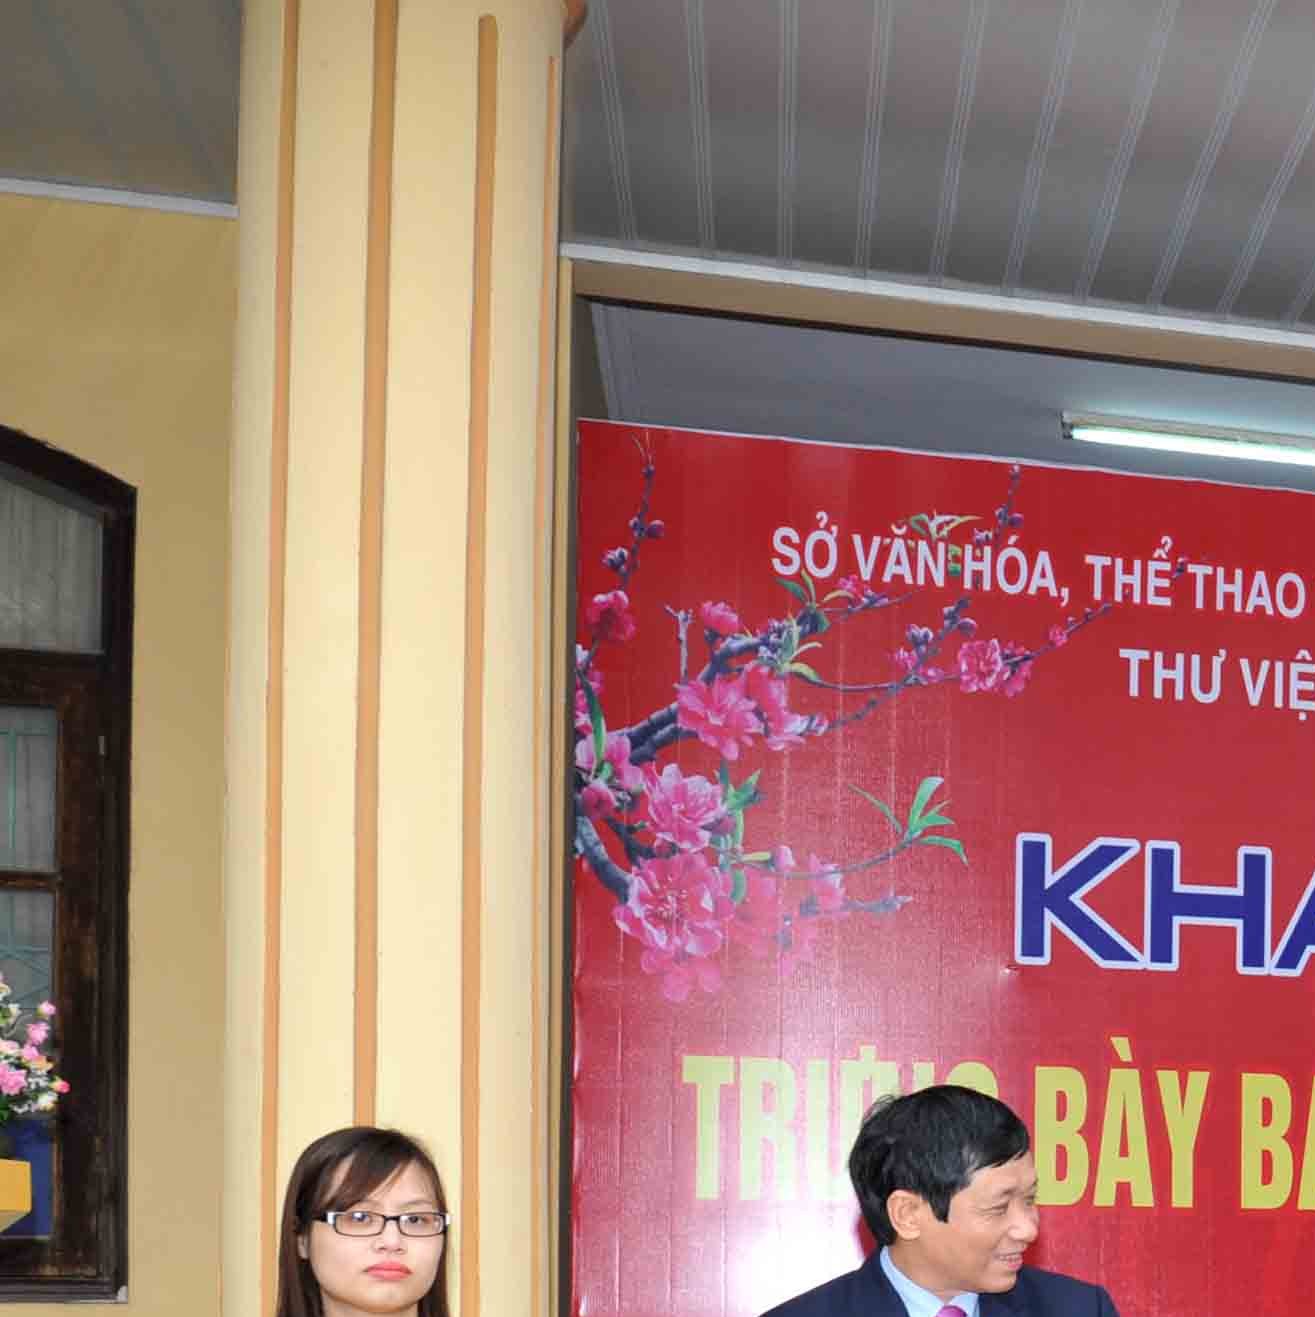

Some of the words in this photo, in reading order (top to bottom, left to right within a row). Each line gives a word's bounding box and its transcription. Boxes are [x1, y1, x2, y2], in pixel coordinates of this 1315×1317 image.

[771, 511, 839, 578] SỞ
[853, 523, 946, 588] VĂN
[962, 534, 1069, 607] HÓA,
[1084, 535, 1173, 607] THỂ
[1187, 562, 1306, 619] THAO
[1119, 648, 1228, 704] THƯ
[683, 1047, 998, 1202] TRƯ
[1034, 1036, 1209, 1209] BÀY
